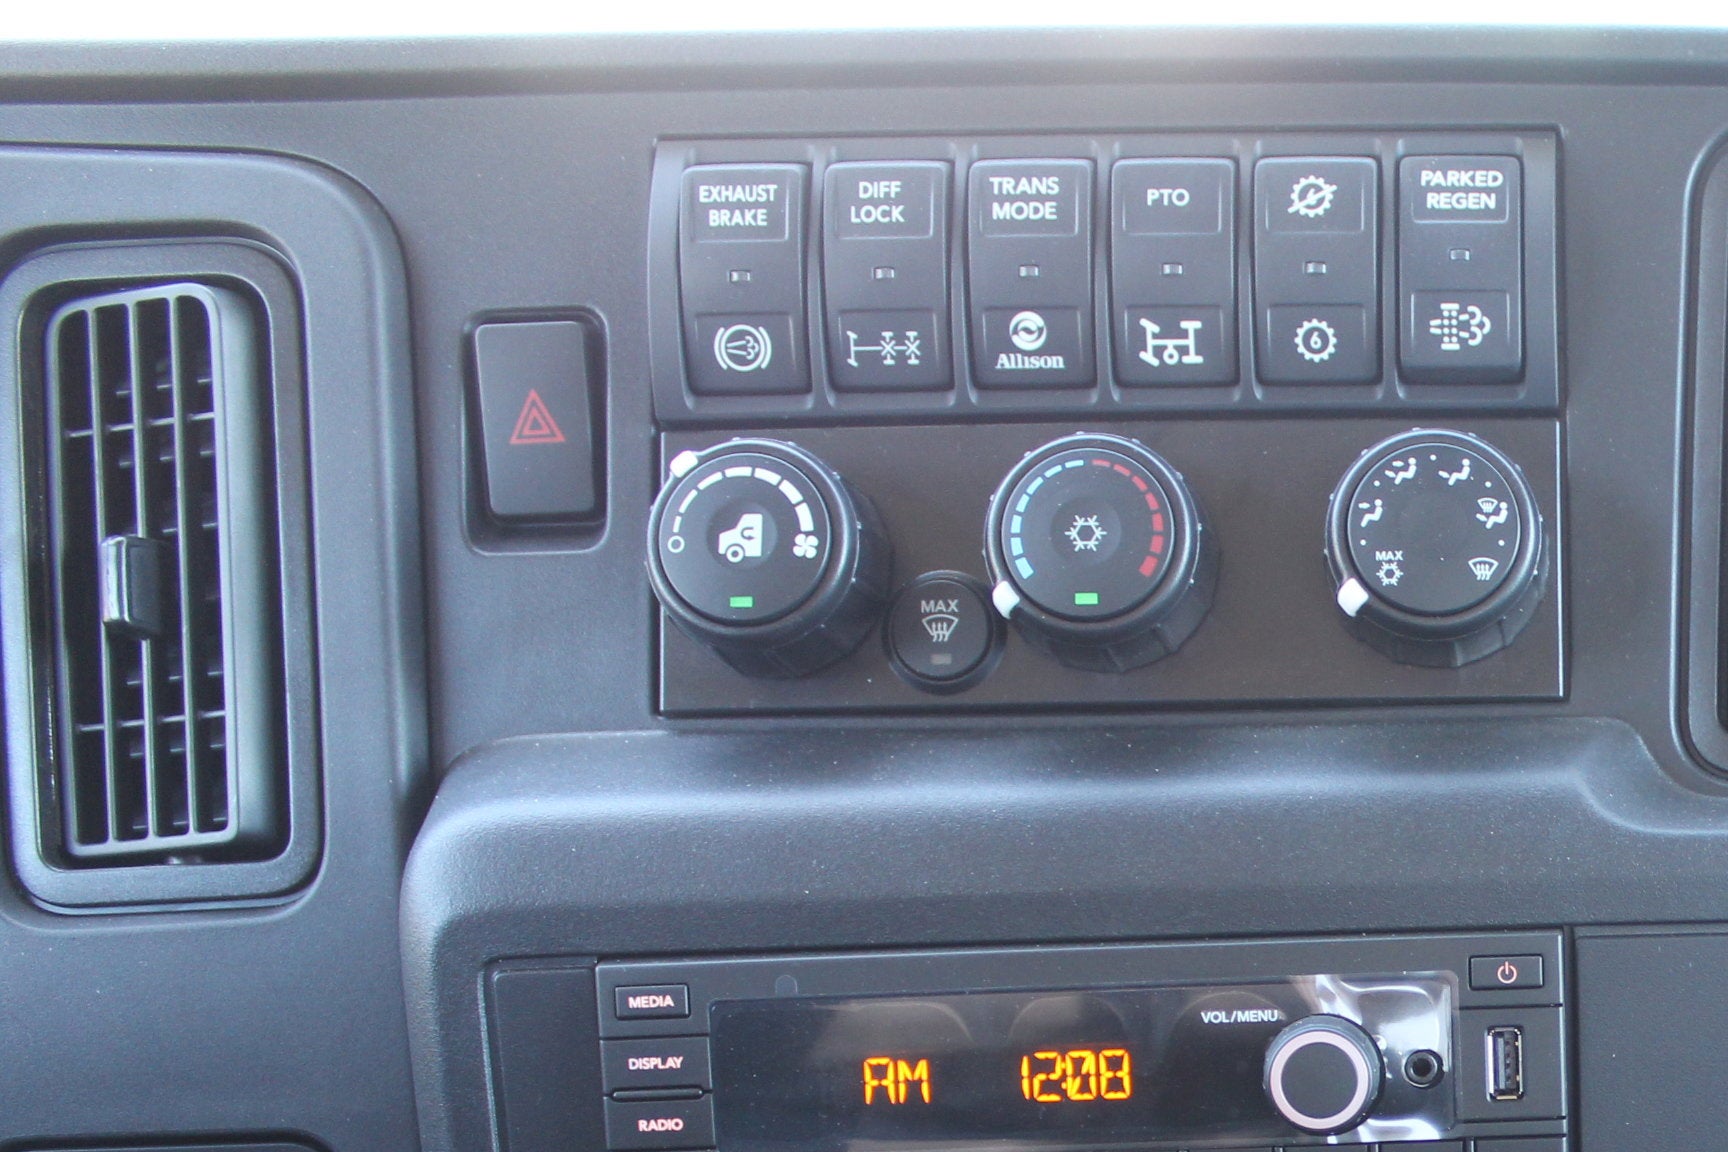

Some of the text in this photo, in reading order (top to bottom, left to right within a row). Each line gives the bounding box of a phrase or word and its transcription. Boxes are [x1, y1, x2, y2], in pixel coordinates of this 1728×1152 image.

[989, 176, 1060, 195] TRANS
[1420, 169, 1503, 188] PARKED
[698, 184, 778, 203] EXHAUST
[858, 181, 901, 199] DIFF
[1146, 187, 1190, 207] PTO
[1426, 192, 1496, 210] REGEN
[708, 208, 768, 227] BRAKE
[850, 205, 905, 223] LOCK
[991, 201, 1058, 220] MODE
[994, 353, 1065, 370] Allison
[1375, 550, 1403, 561] MAX
[920, 599, 959, 613] MAX
[628, 993, 675, 1009] MEDIA
[1200, 1008, 1279, 1025] VOL/MENU
[628, 1055, 684, 1071] DISPLAY
[862, 1048, 1133, 1106] AM 12:08
[638, 1117, 684, 1133] RADIO
